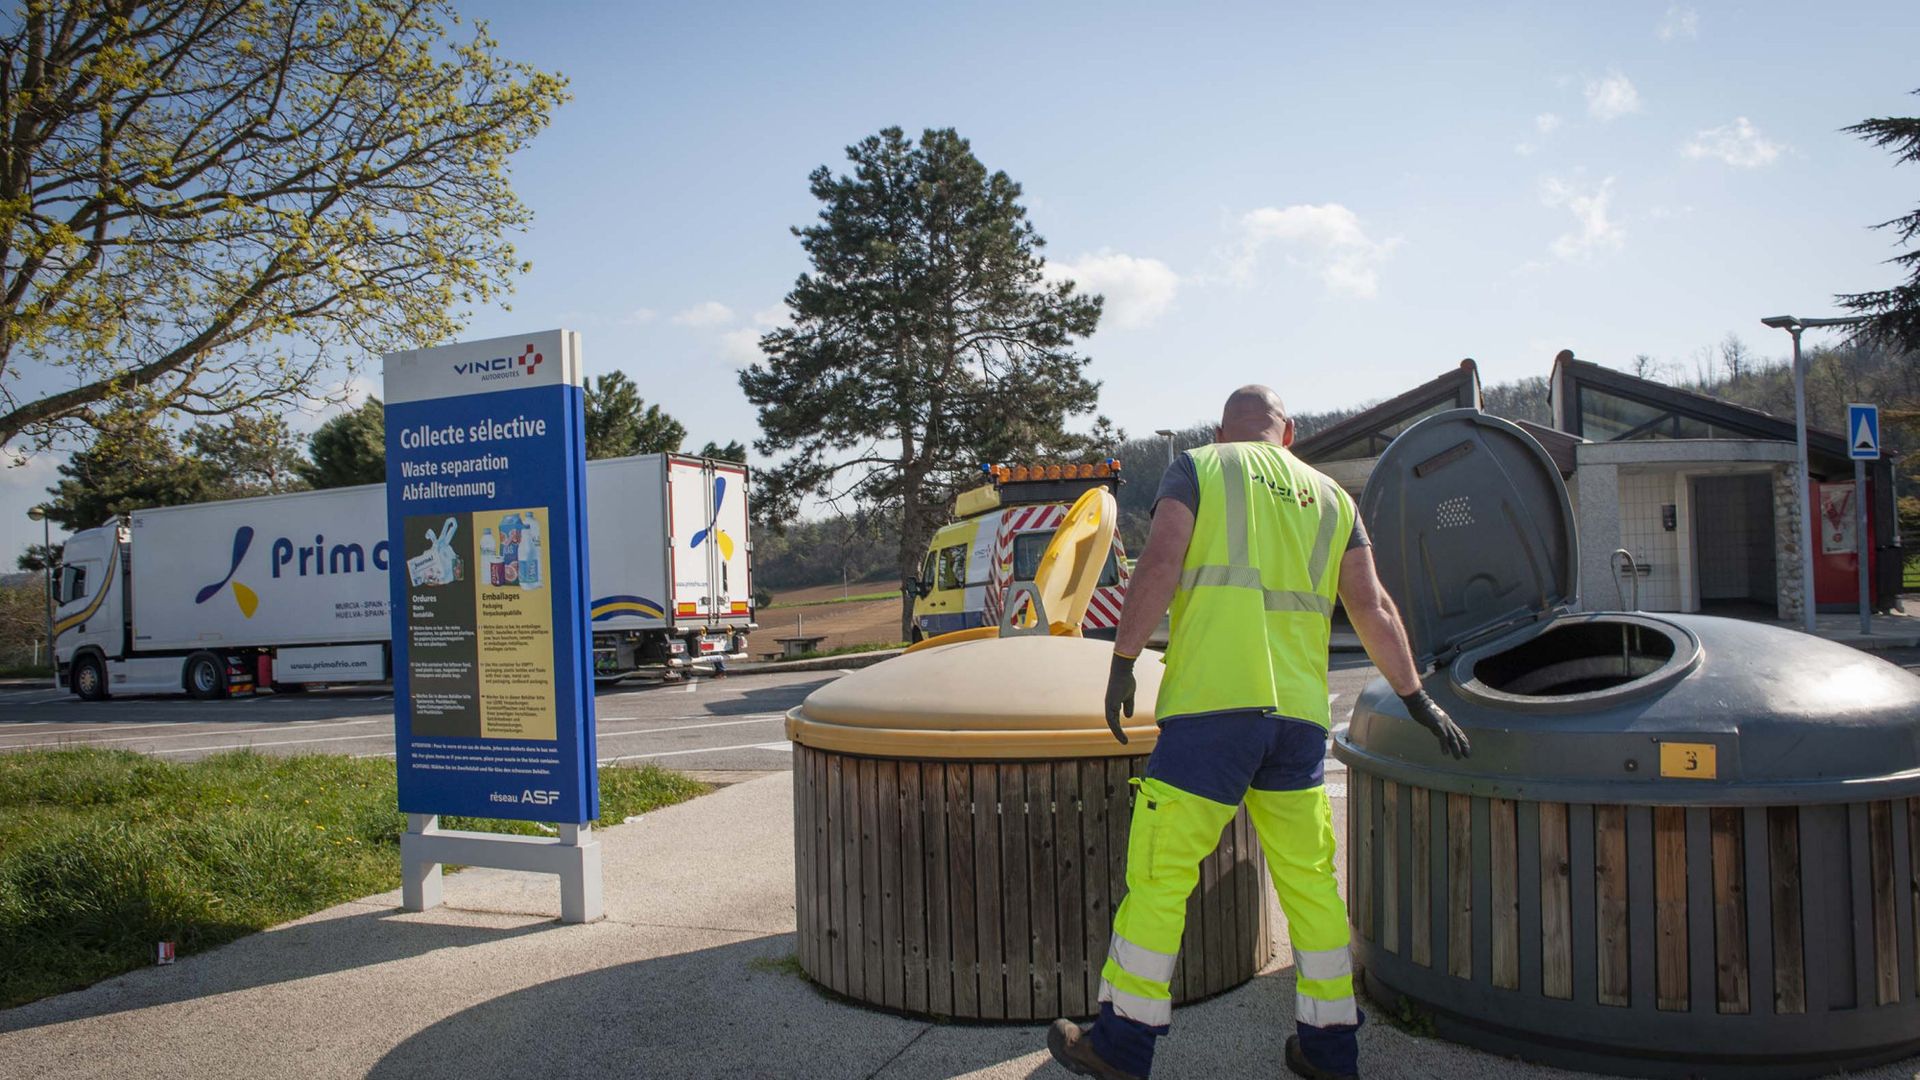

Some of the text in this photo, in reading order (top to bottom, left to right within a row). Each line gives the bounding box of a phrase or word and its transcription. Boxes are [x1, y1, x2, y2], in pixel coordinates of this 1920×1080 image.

[454, 357, 512, 375] VINCI
[481, 371, 520, 381] AUTOROUTES
[400, 415, 546, 449] Collecte sélective
[401, 454, 509, 477] Waste separation
[402, 481, 496, 500] Abfalltrennung
[482, 592, 520, 601] Emballages
[290, 660, 367, 670] www.primafrio.com
[490, 789, 560, 805] réseau ASF
